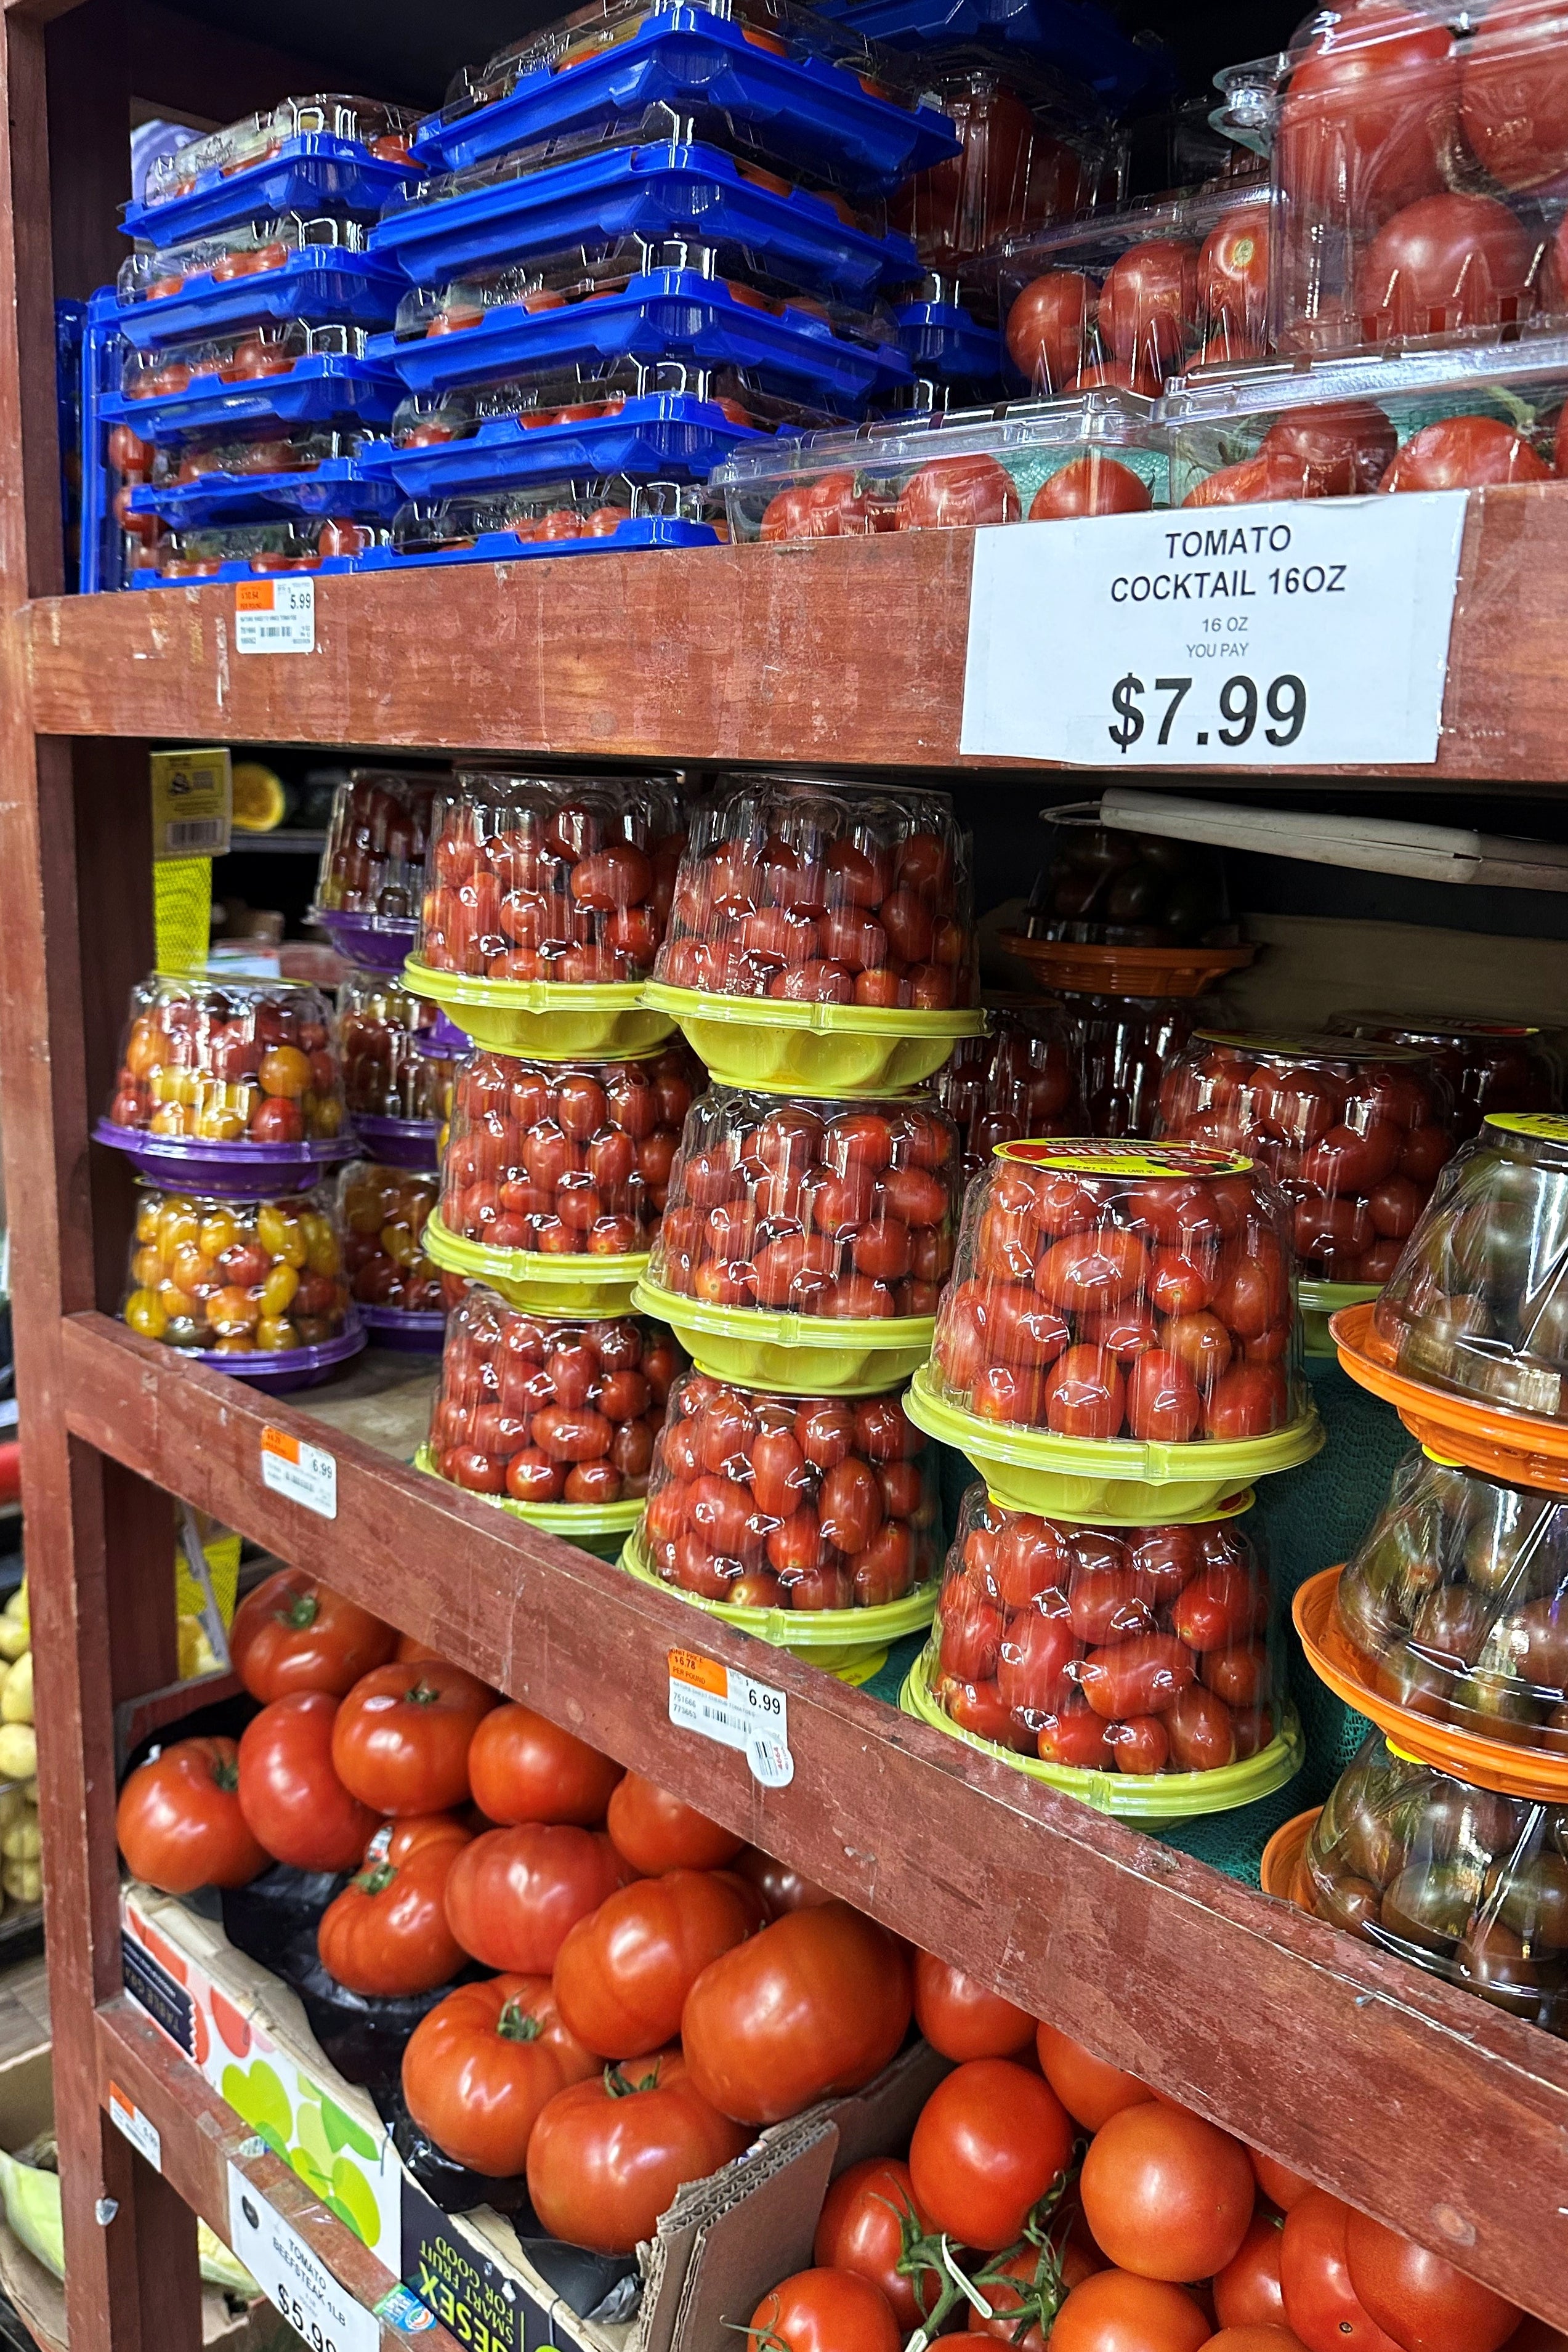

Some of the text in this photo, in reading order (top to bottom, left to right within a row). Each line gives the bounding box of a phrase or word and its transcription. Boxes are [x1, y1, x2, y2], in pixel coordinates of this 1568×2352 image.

[1165, 524, 1291, 559] TOMATO
[1110, 564, 1348, 603] COCKTAIL 16OZ
[290, 592, 312, 610] 5.99
[1202, 616, 1249, 633] 16 OZ
[1186, 642, 1250, 658] YOU PAY
[1107, 671, 1307, 754] $7.99
[1046, 1147, 1191, 1158] CHERUBS
[312, 1458, 333, 1479] 6.99
[674, 1655, 696, 1670] $6.78
[686, 1652, 703, 1663] PRICE
[673, 1666, 706, 1685] PER POUND
[748, 1688, 781, 1715] 6.99
[288, 2238, 327, 2290] TOMATO
[419, 2239, 460, 2291] FRUIT
[272, 2236, 326, 2306] BEEFSTEAK
[327, 2301, 346, 2327] 1LB
[435, 2236, 514, 2326] FOR GOOD
[464, 2284, 515, 2345] SMART
